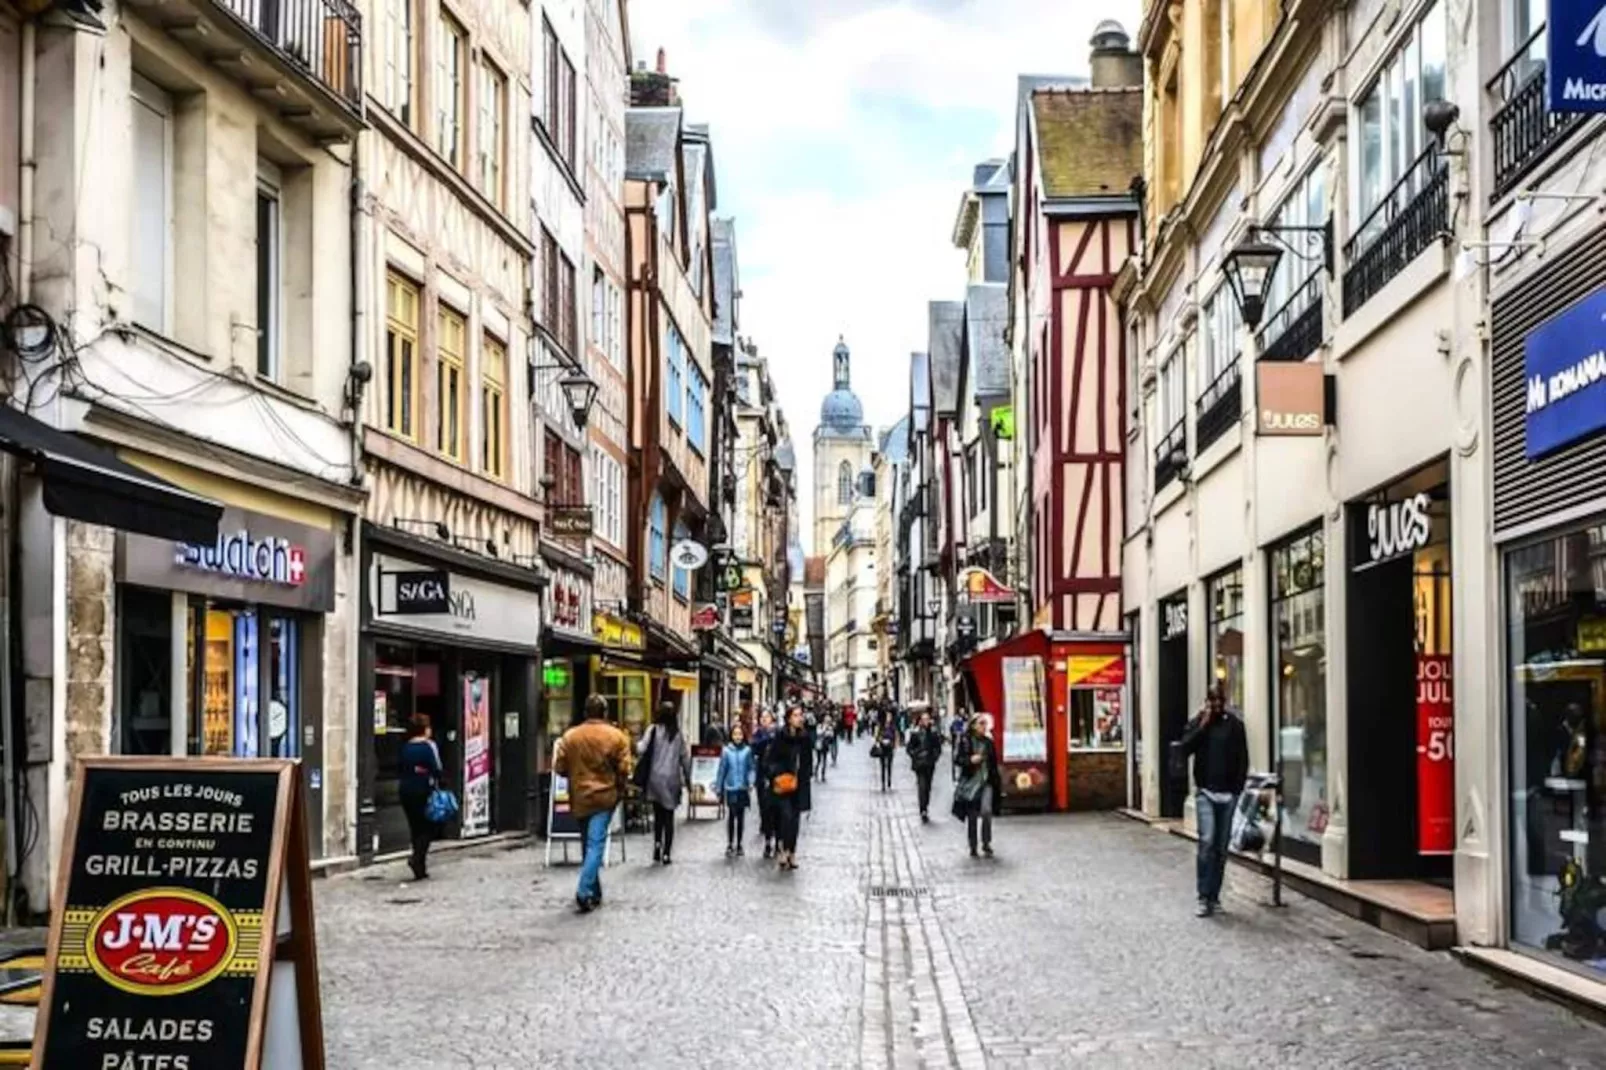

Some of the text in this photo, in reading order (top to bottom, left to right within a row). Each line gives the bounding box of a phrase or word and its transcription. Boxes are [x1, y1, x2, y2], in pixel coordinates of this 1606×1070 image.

[400, 580, 445, 601] SIGA
[120, 783, 244, 807] TOUS LES JOURS
[103, 810, 255, 833] BRASSERIE
[135, 837, 216, 850] EN CONTINU
[120, 952, 193, 981] Café
[86, 1017, 214, 1042] SALADES
[100, 1049, 190, 1070] PÂTES
